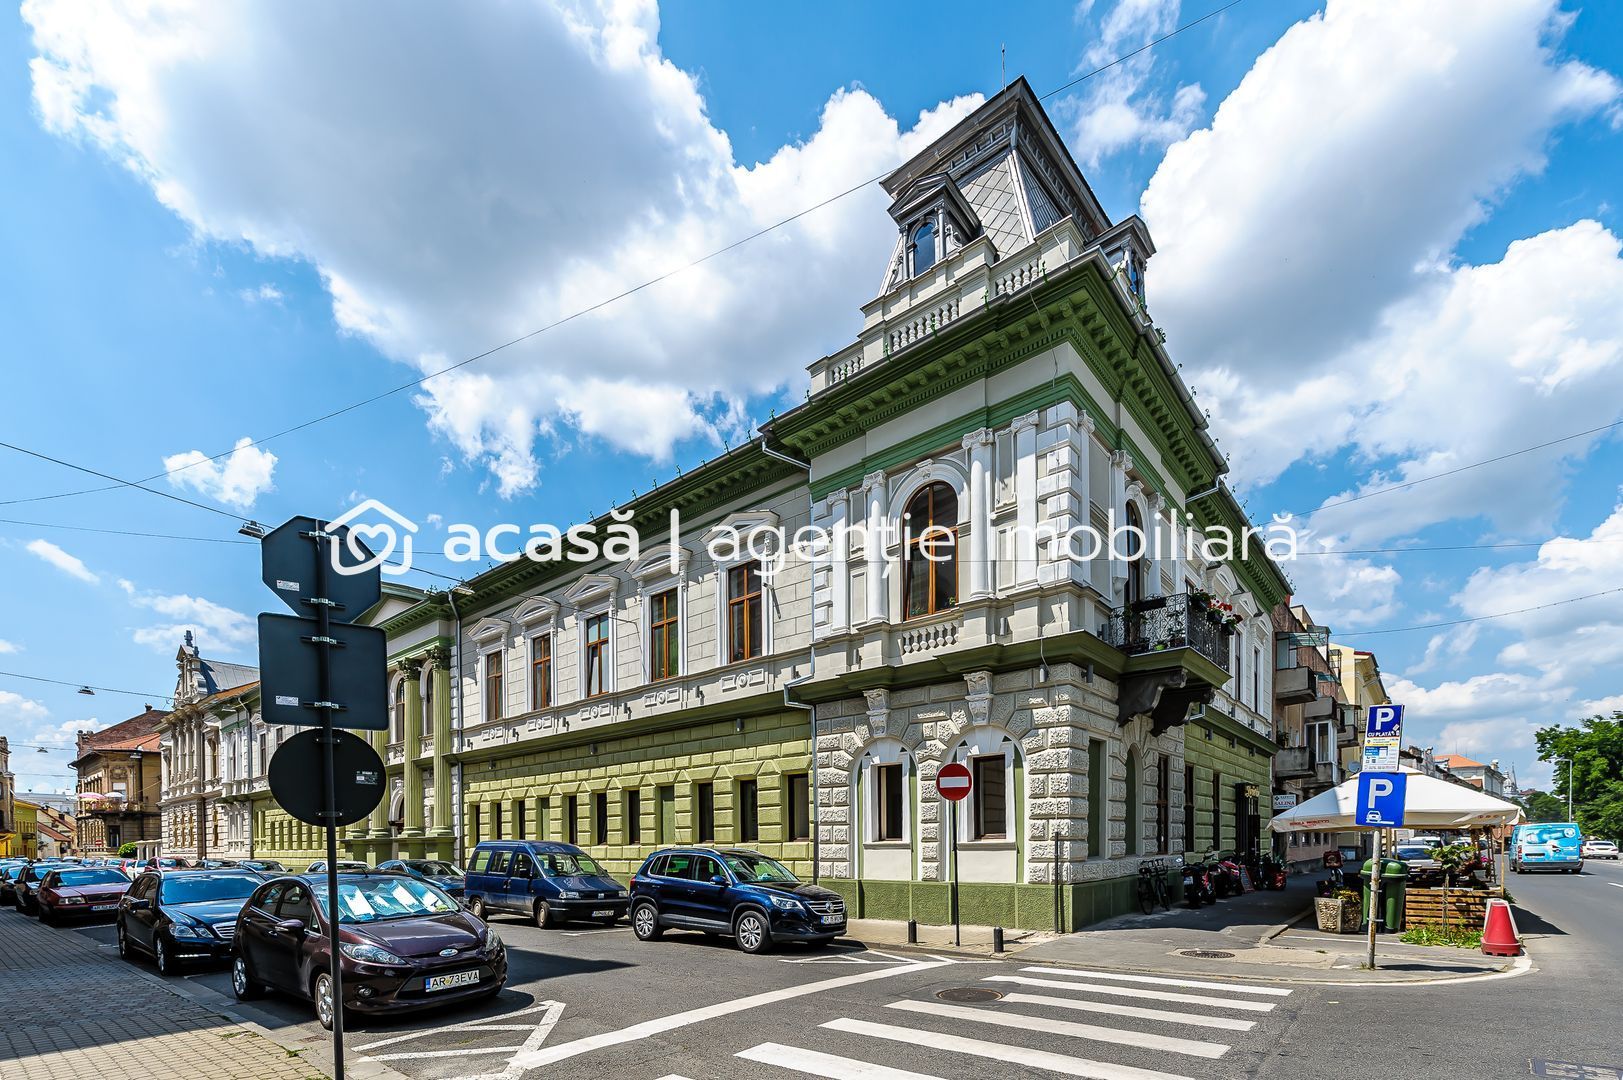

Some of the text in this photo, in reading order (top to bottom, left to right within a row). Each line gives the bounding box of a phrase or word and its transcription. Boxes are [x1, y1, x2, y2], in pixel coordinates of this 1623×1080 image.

[1375, 707, 1395, 730] P
[1368, 778, 1394, 808] P
[432, 971, 478, 988] AR 73EVA
